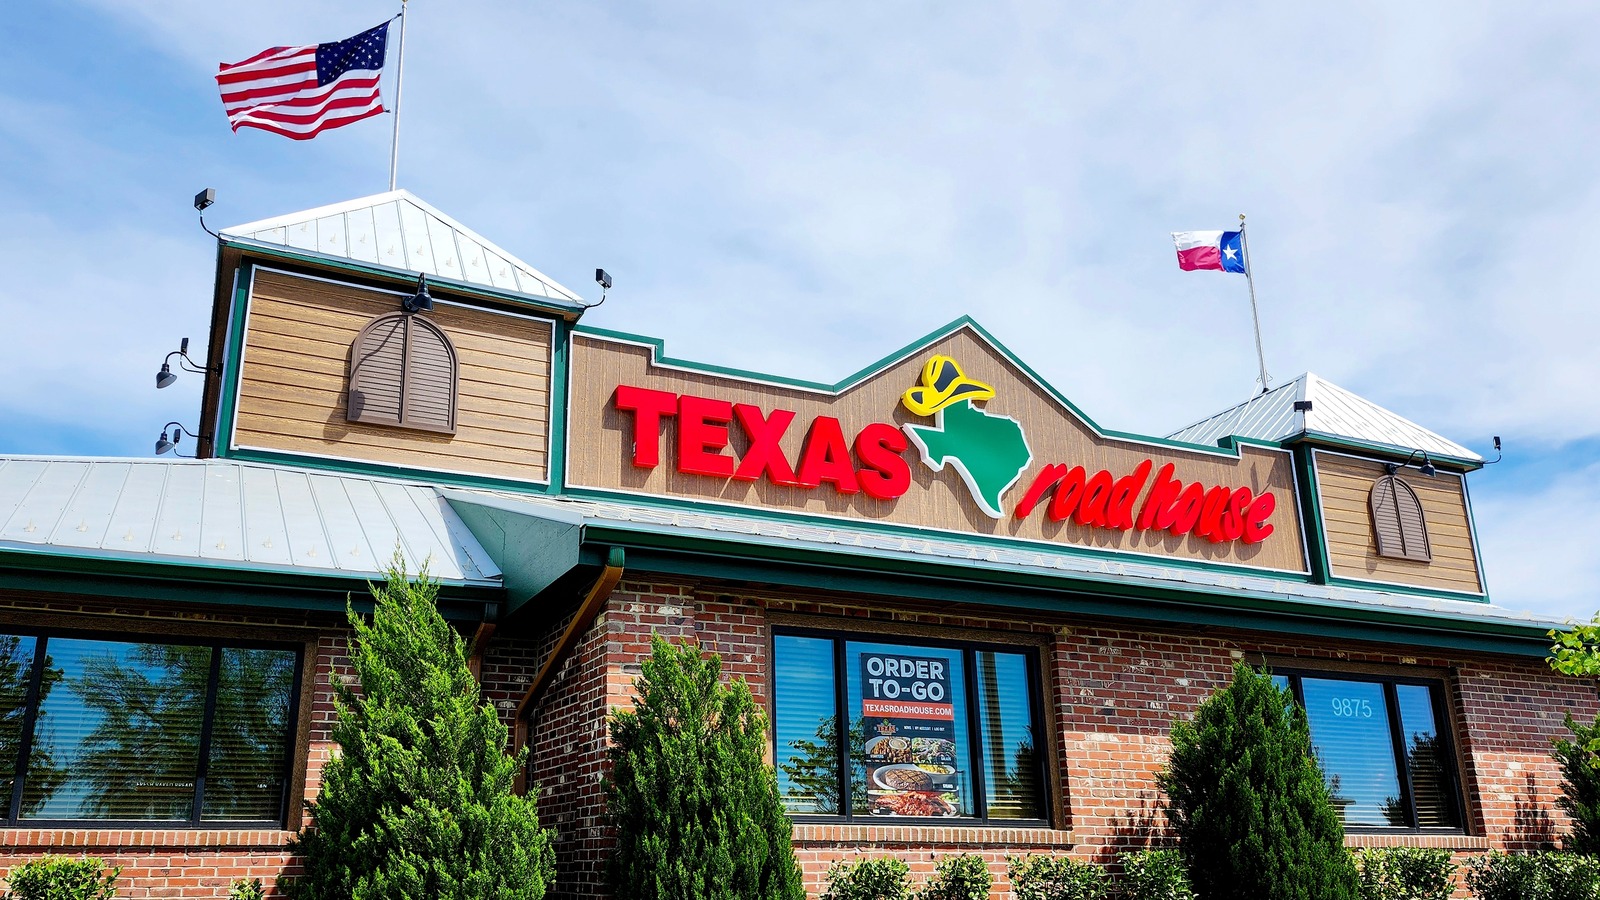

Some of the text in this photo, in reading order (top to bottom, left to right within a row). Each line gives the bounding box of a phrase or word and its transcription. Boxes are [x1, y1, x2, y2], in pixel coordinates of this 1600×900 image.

[615, 384, 912, 500] TEXAS
[867, 657, 944, 680] ORDER
[869, 678, 944, 701] TO-GO
[865, 703, 952, 716] TEXASROADHOUSE.COM
[1331, 697, 1372, 718] 9875
